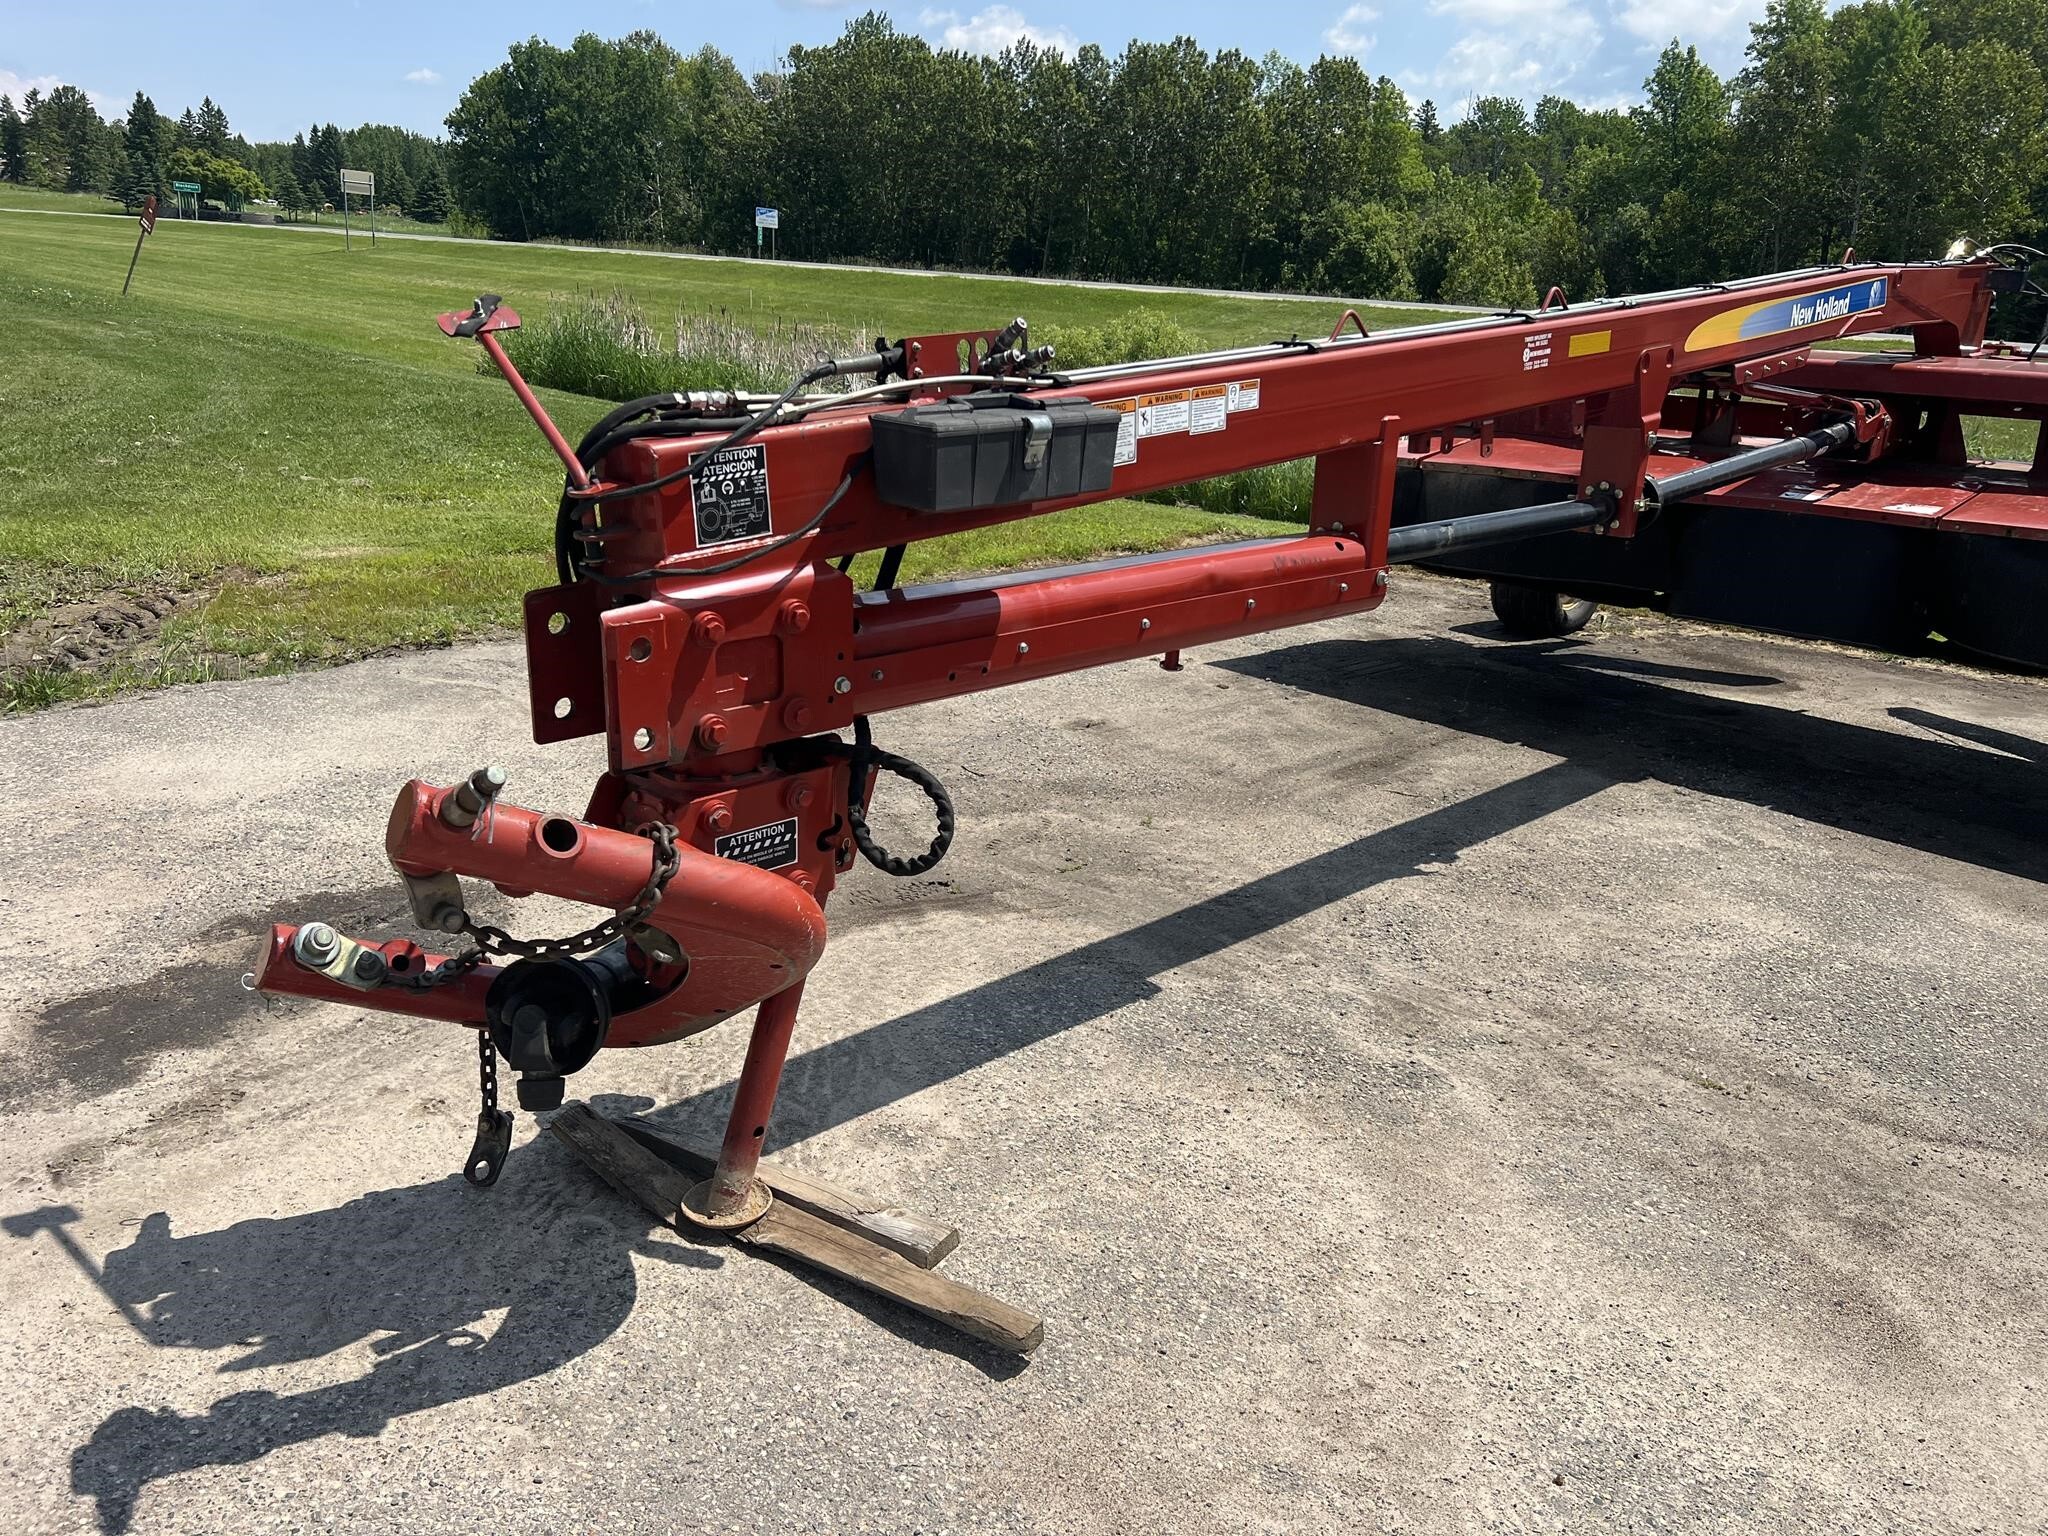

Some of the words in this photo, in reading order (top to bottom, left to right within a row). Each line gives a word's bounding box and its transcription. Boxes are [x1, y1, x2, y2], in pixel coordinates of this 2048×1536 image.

[1790, 303, 1814, 327] New
[1814, 291, 1851, 322] Holland
[1155, 393, 1183, 403] WARNING
[1201, 387, 1223, 397] WARNING
[703, 459, 755, 476] ATENCIÓN
[730, 824, 784, 847] ATTENTION
